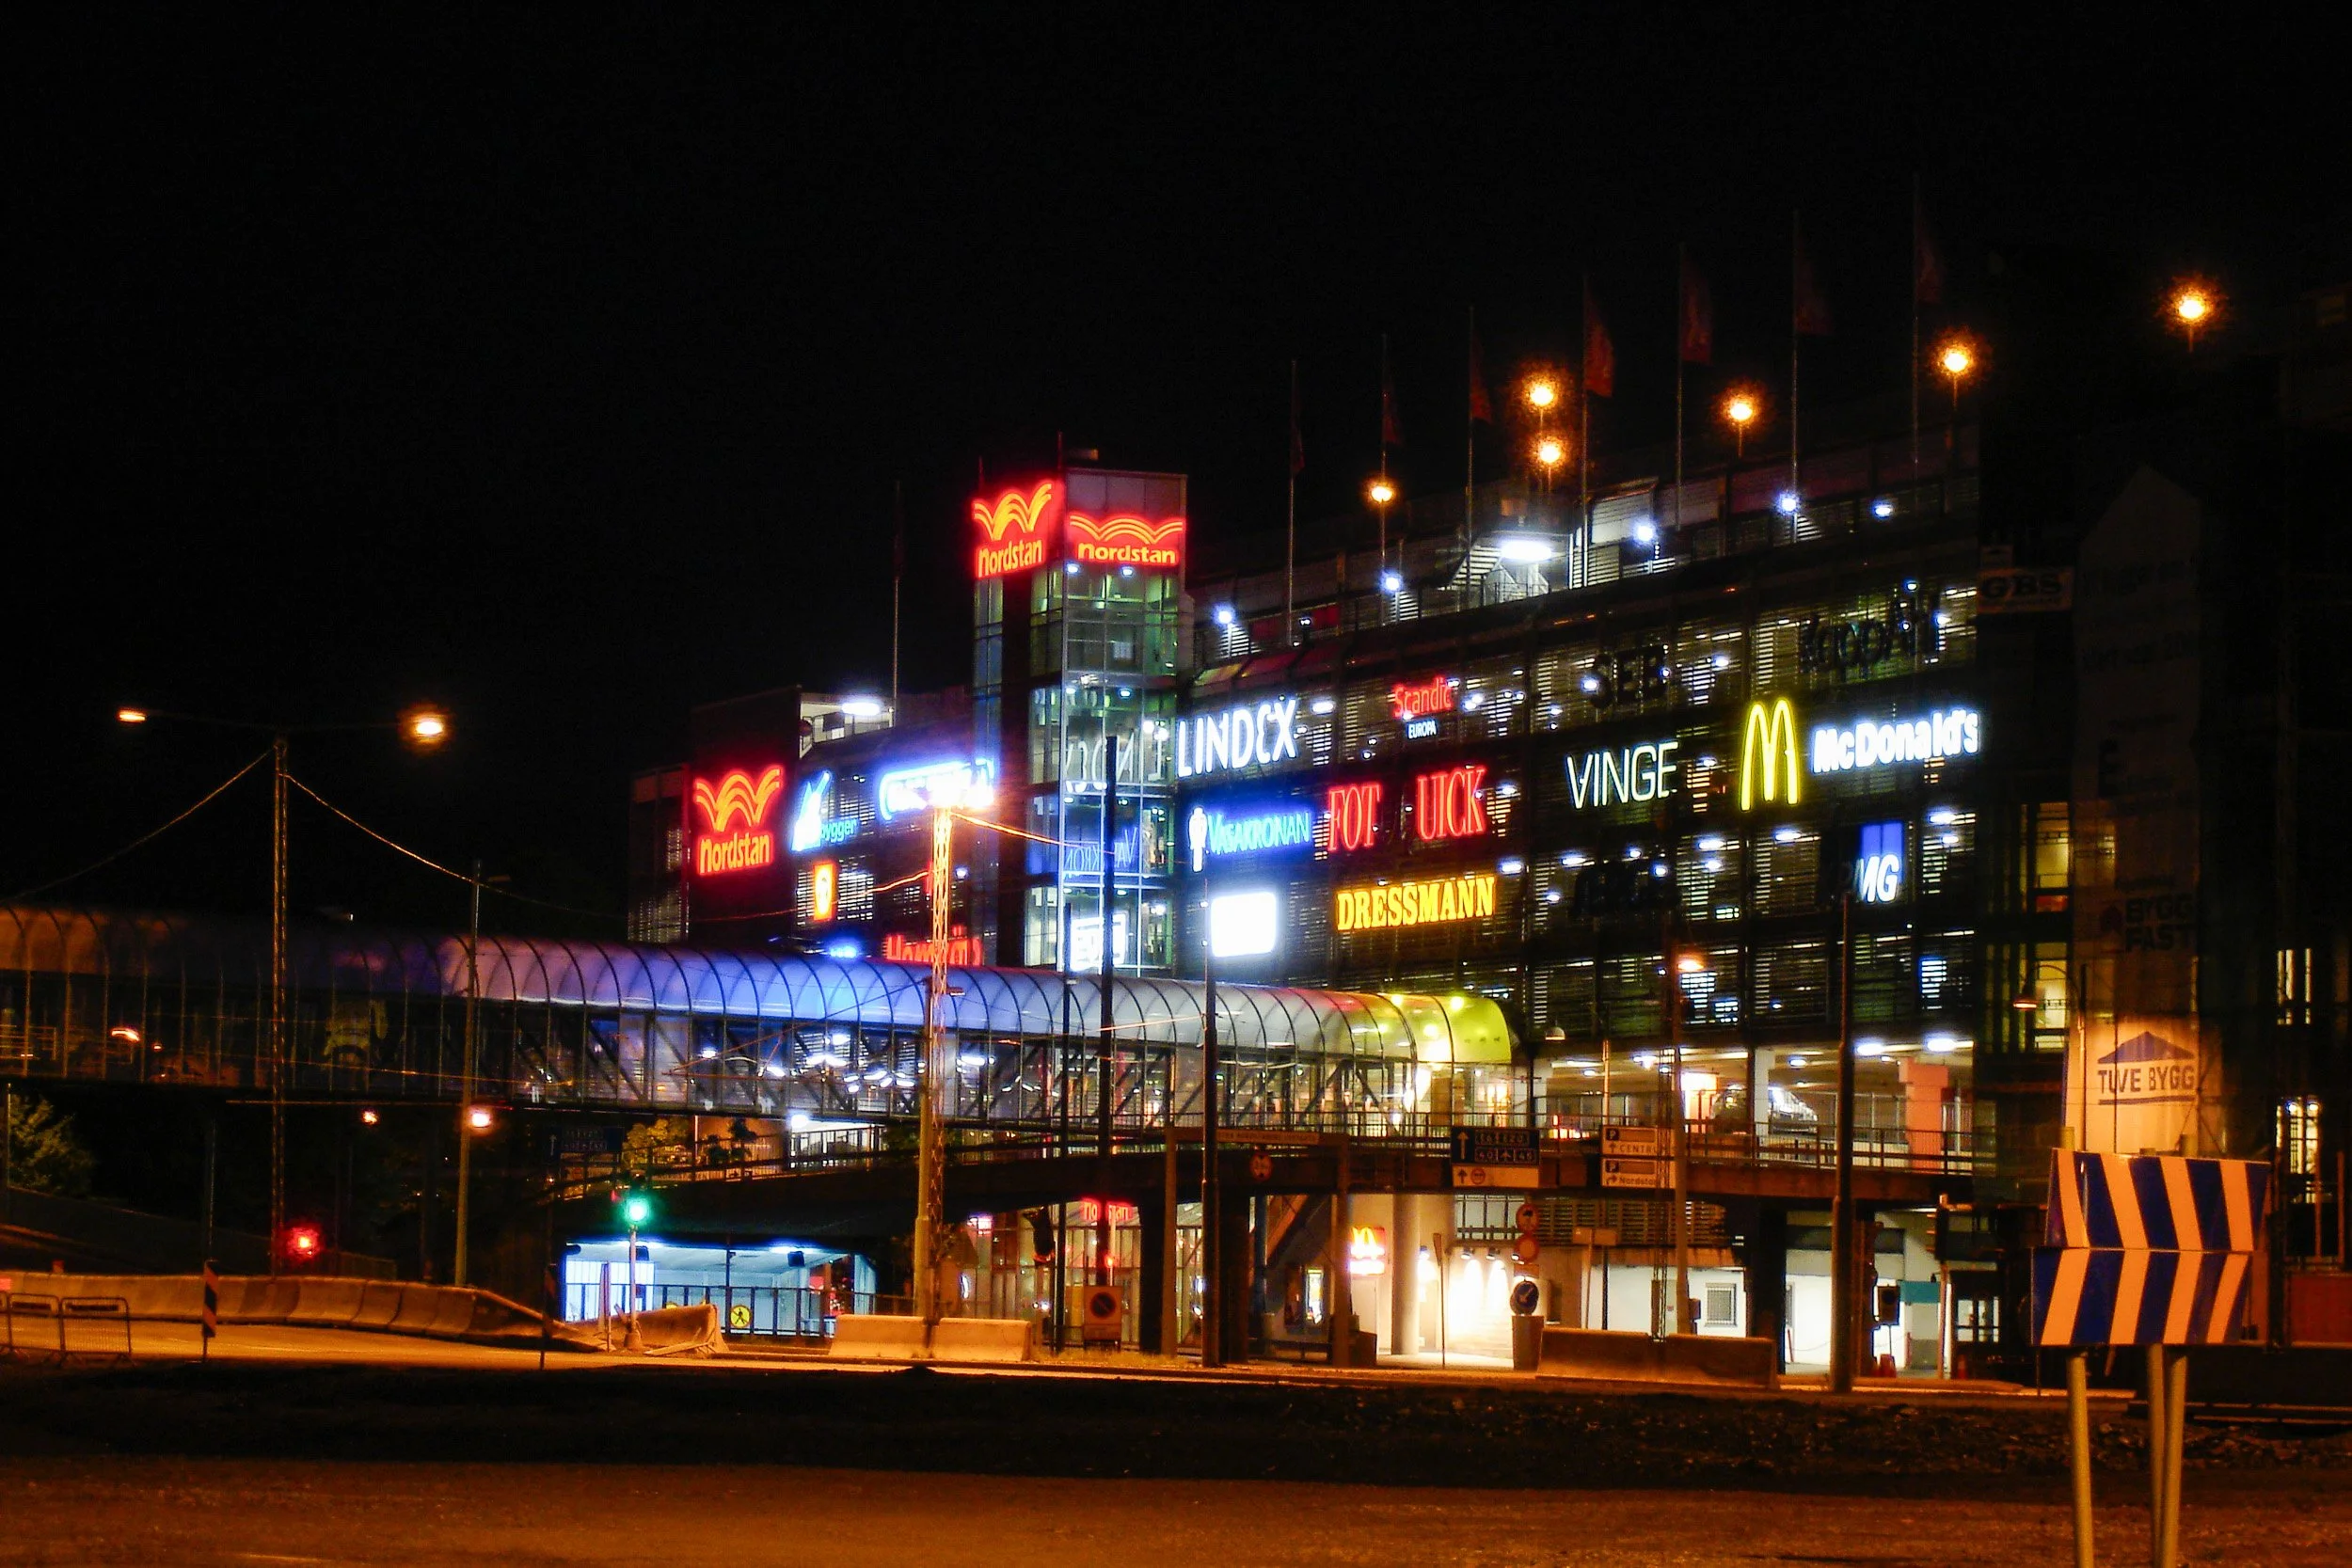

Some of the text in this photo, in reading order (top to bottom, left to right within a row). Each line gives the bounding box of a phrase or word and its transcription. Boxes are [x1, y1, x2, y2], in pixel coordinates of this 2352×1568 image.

[977, 539, 1043, 578] nordstan
[1077, 543, 1177, 564] nordstan
[1393, 676, 1454, 718] Scandic
[1406, 719, 1438, 739] EUROPA
[1812, 707, 1980, 773] McDonald's
[1565, 740, 1679, 809] VINGE
[698, 832, 771, 876] nordstan
[1336, 875, 1496, 931] DRESSMANN
[2097, 1065, 2195, 1095] TUVE BYGG
